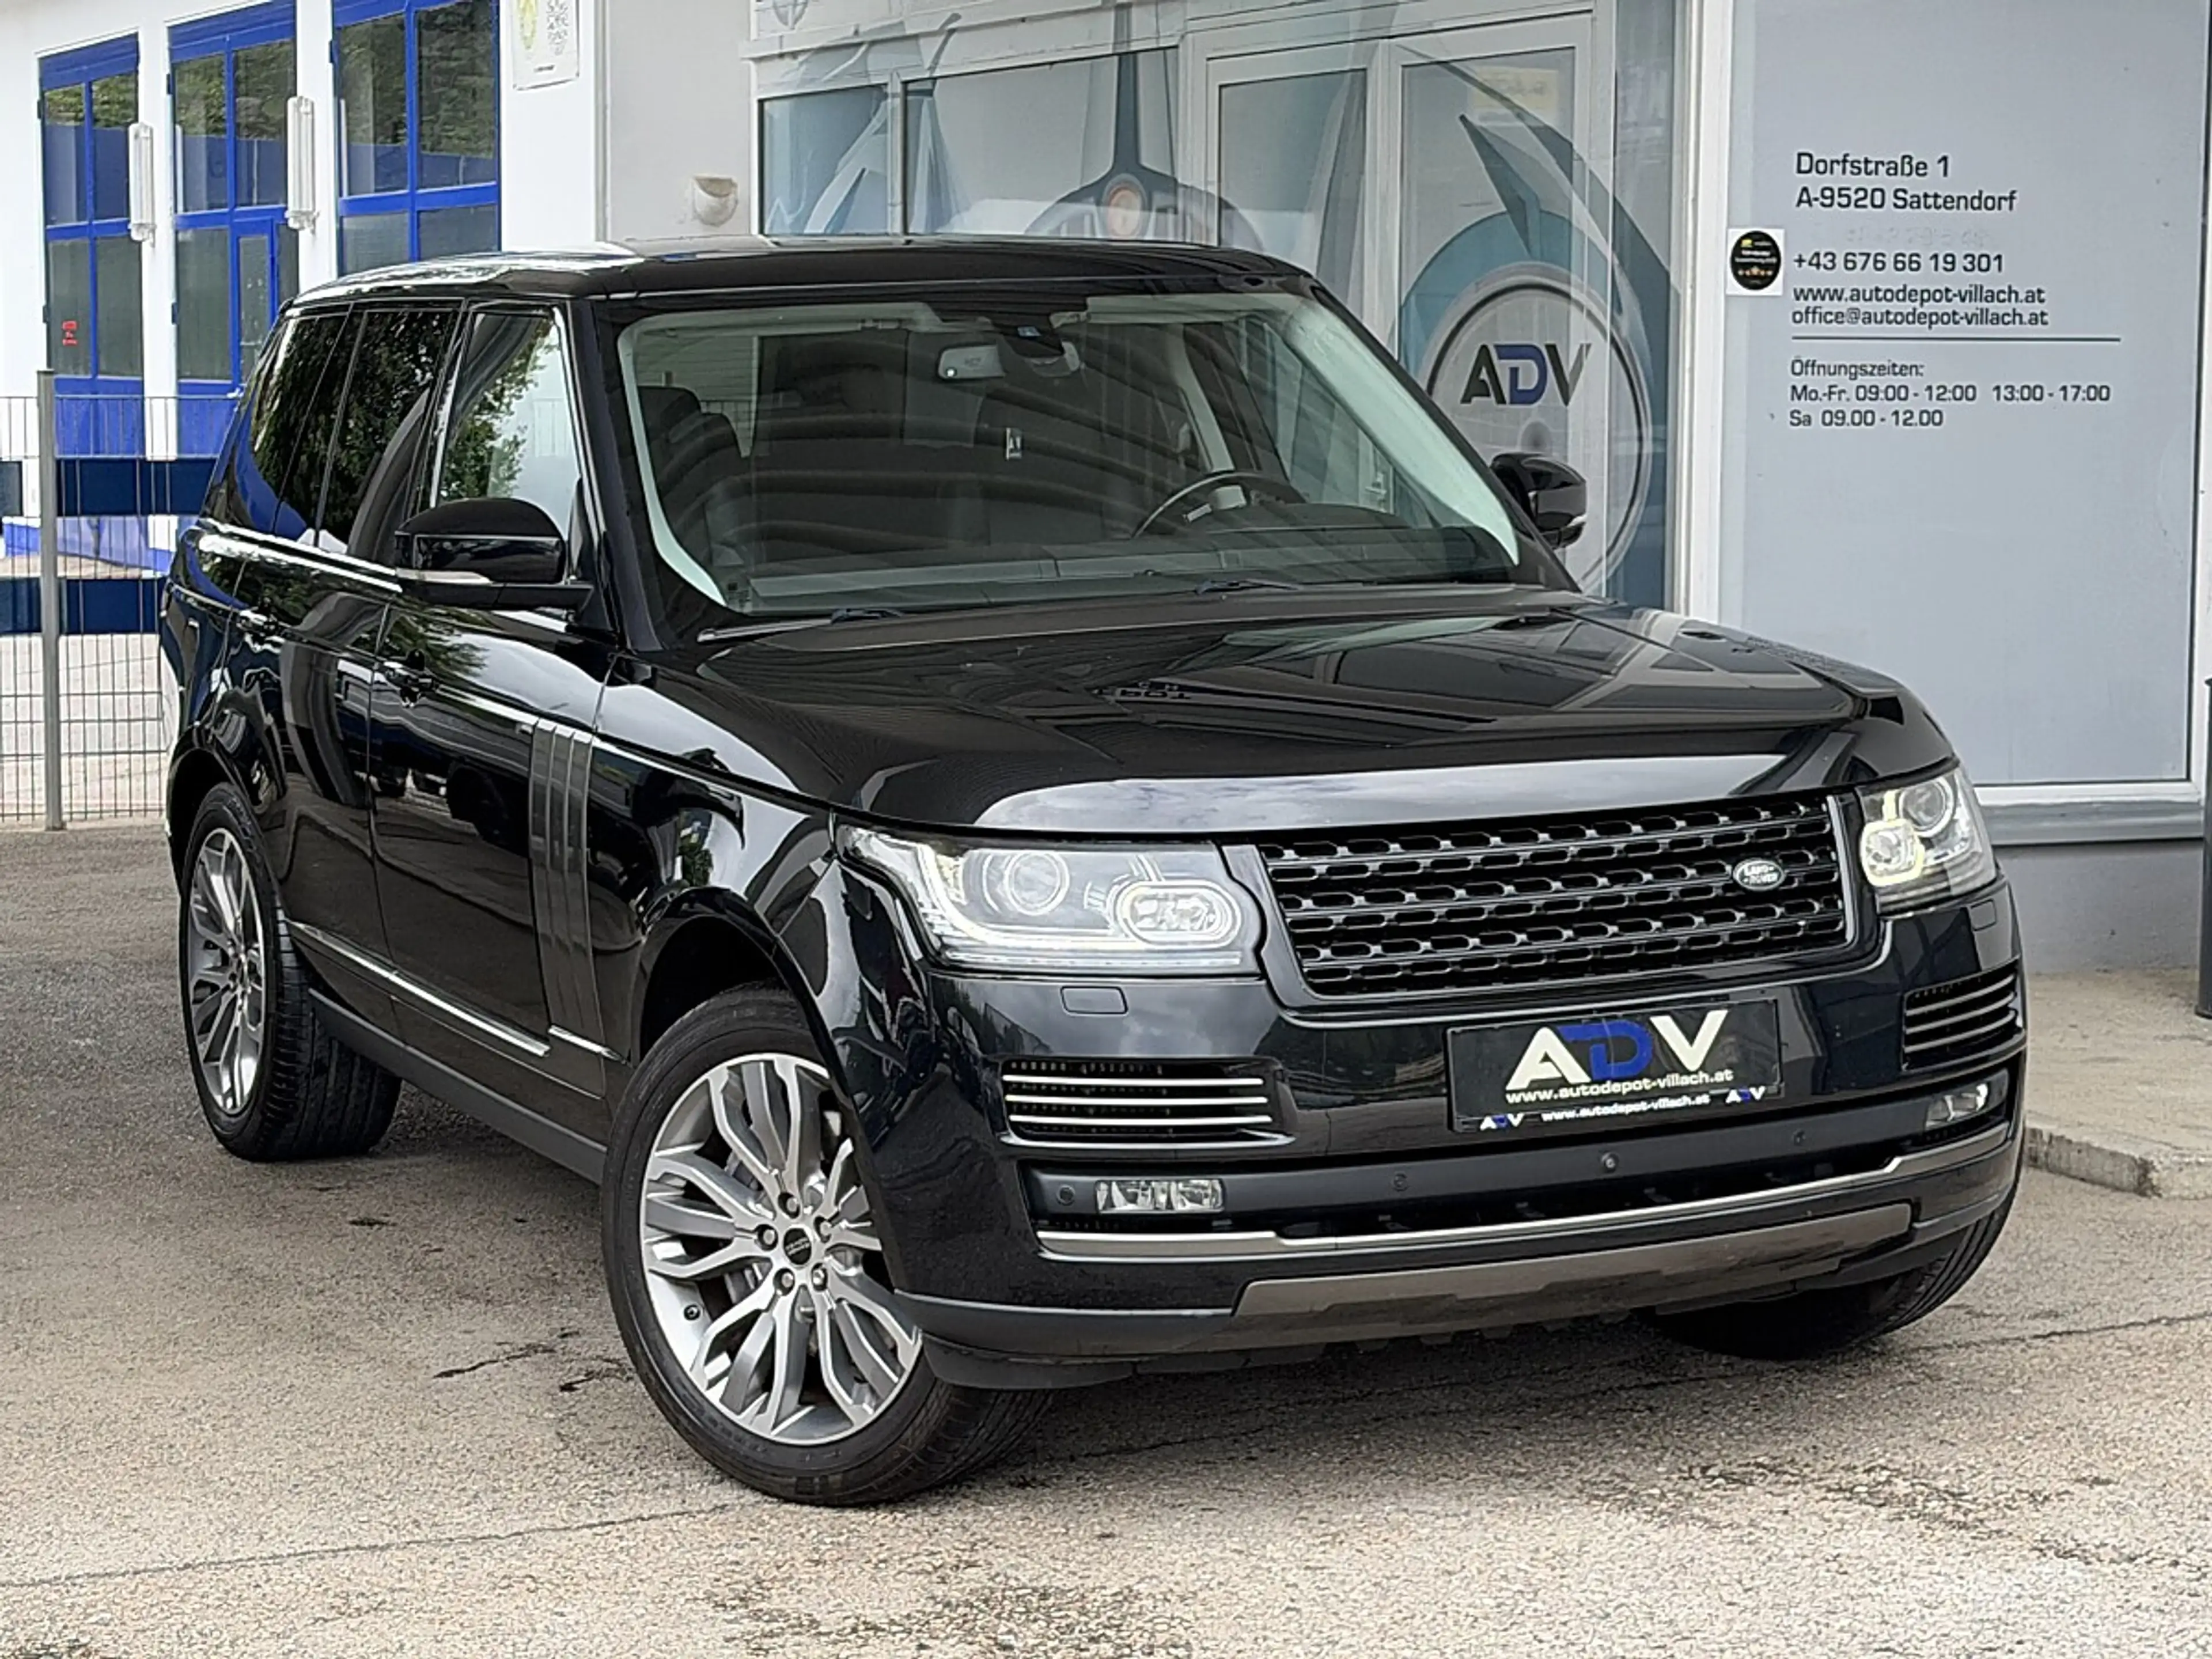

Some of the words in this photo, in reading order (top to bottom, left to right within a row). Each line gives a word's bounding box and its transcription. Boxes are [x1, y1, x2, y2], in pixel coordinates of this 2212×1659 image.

[1796, 151, 1929, 178] Dorfstraße
[1936, 154, 1950, 179] 1
[1794, 185, 1887, 210] A-9520
[1892, 187, 2018, 212] Sattendorf
[1793, 251, 1838, 271] +43
[1843, 251, 1887, 272] 676
[1892, 251, 1922, 272] 66
[1929, 252, 1957, 273] 19
[1961, 252, 2003, 274] 301
[1793, 283, 2046, 308] www.autodepot-villach.at
[1791, 306, 2050, 330] office@autodepot-villach.at
[1460, 343, 1592, 407] ADV
[1790, 355, 1925, 381] Öffnungszeiten:
[1790, 384, 1850, 402] Mo.-Fr.
[1855, 384, 1910, 402] 09:00
[1924, 384, 1978, 402] 12:00
[1991, 384, 2045, 402] 13:00
[2058, 384, 2111, 402] 17:00
[1789, 408, 1812, 427] Sa
[1821, 408, 1876, 427] 09.00
[1891, 408, 1944, 427] 12.00
[1505, 1009, 1729, 1090] ADV
[1505, 1068, 1734, 1104] www.autodepot-villach.at
